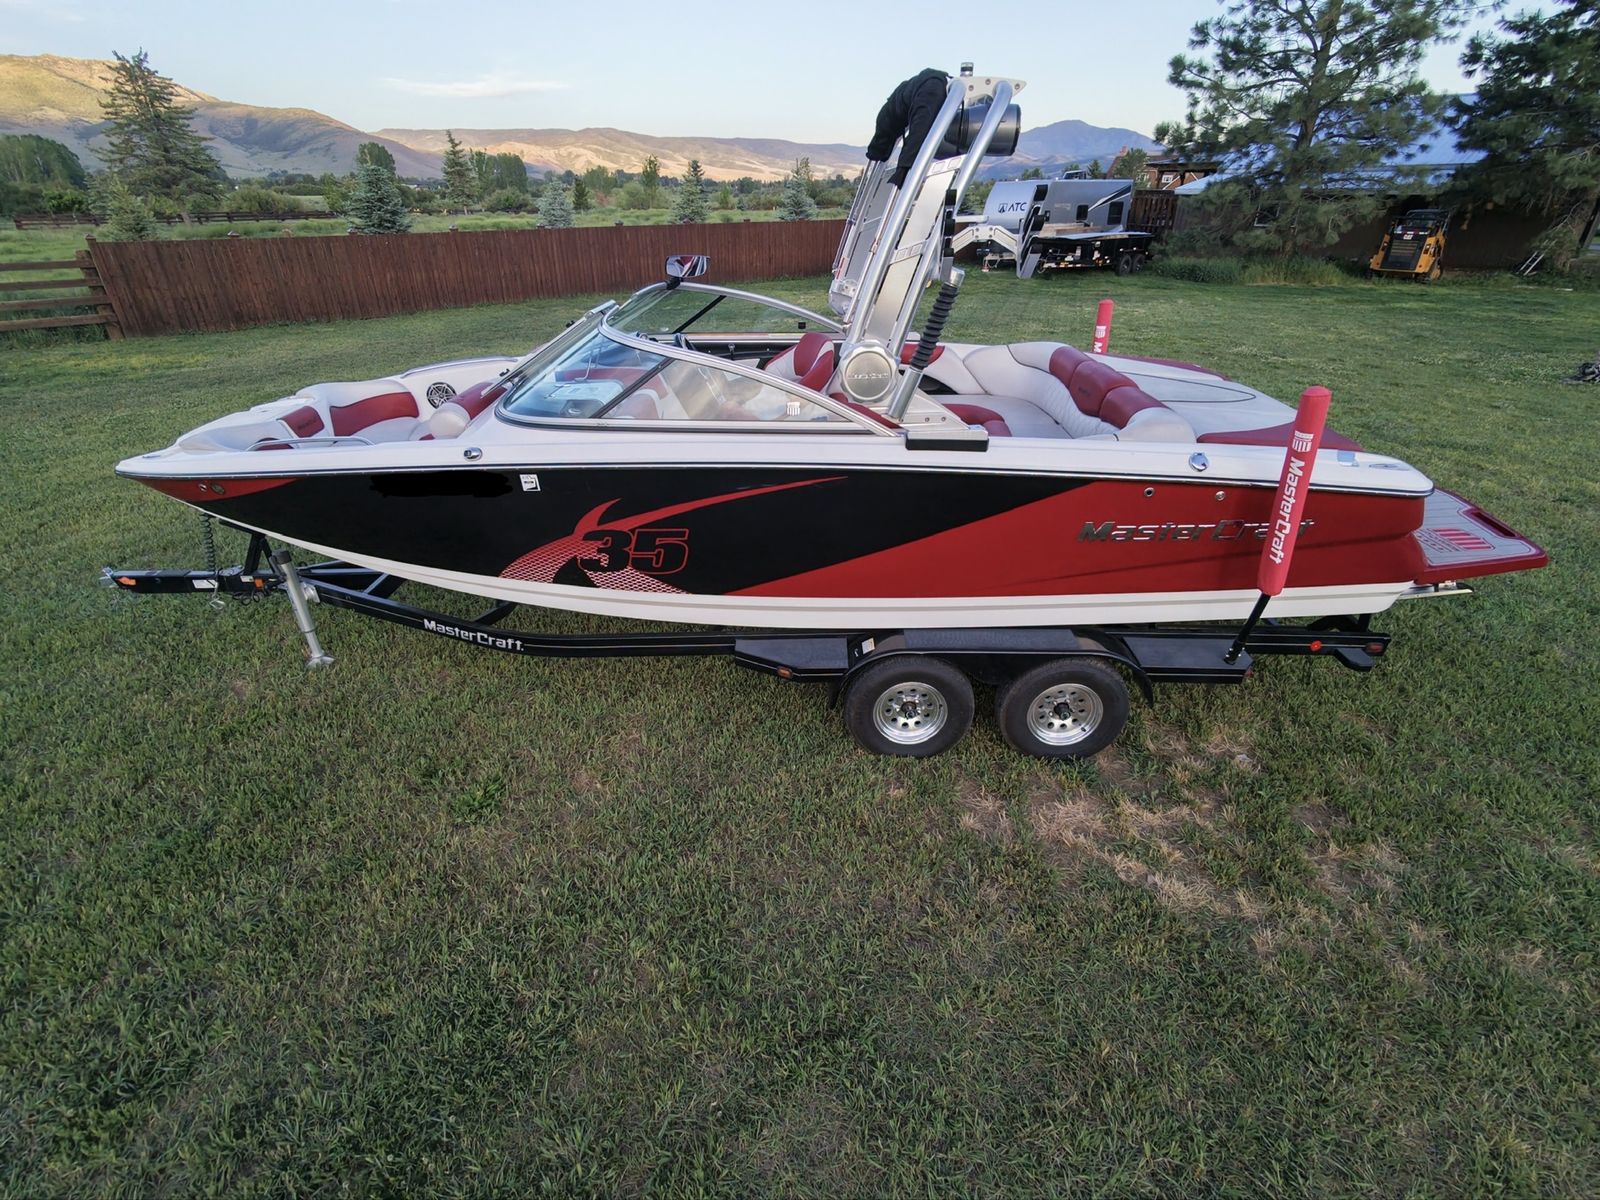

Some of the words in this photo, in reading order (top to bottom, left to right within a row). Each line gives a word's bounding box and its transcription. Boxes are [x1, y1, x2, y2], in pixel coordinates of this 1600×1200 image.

[1008, 202, 1028, 213] ATC
[1269, 456, 1305, 564] MasterCraft
[1078, 519, 1315, 543] MasterCrat
